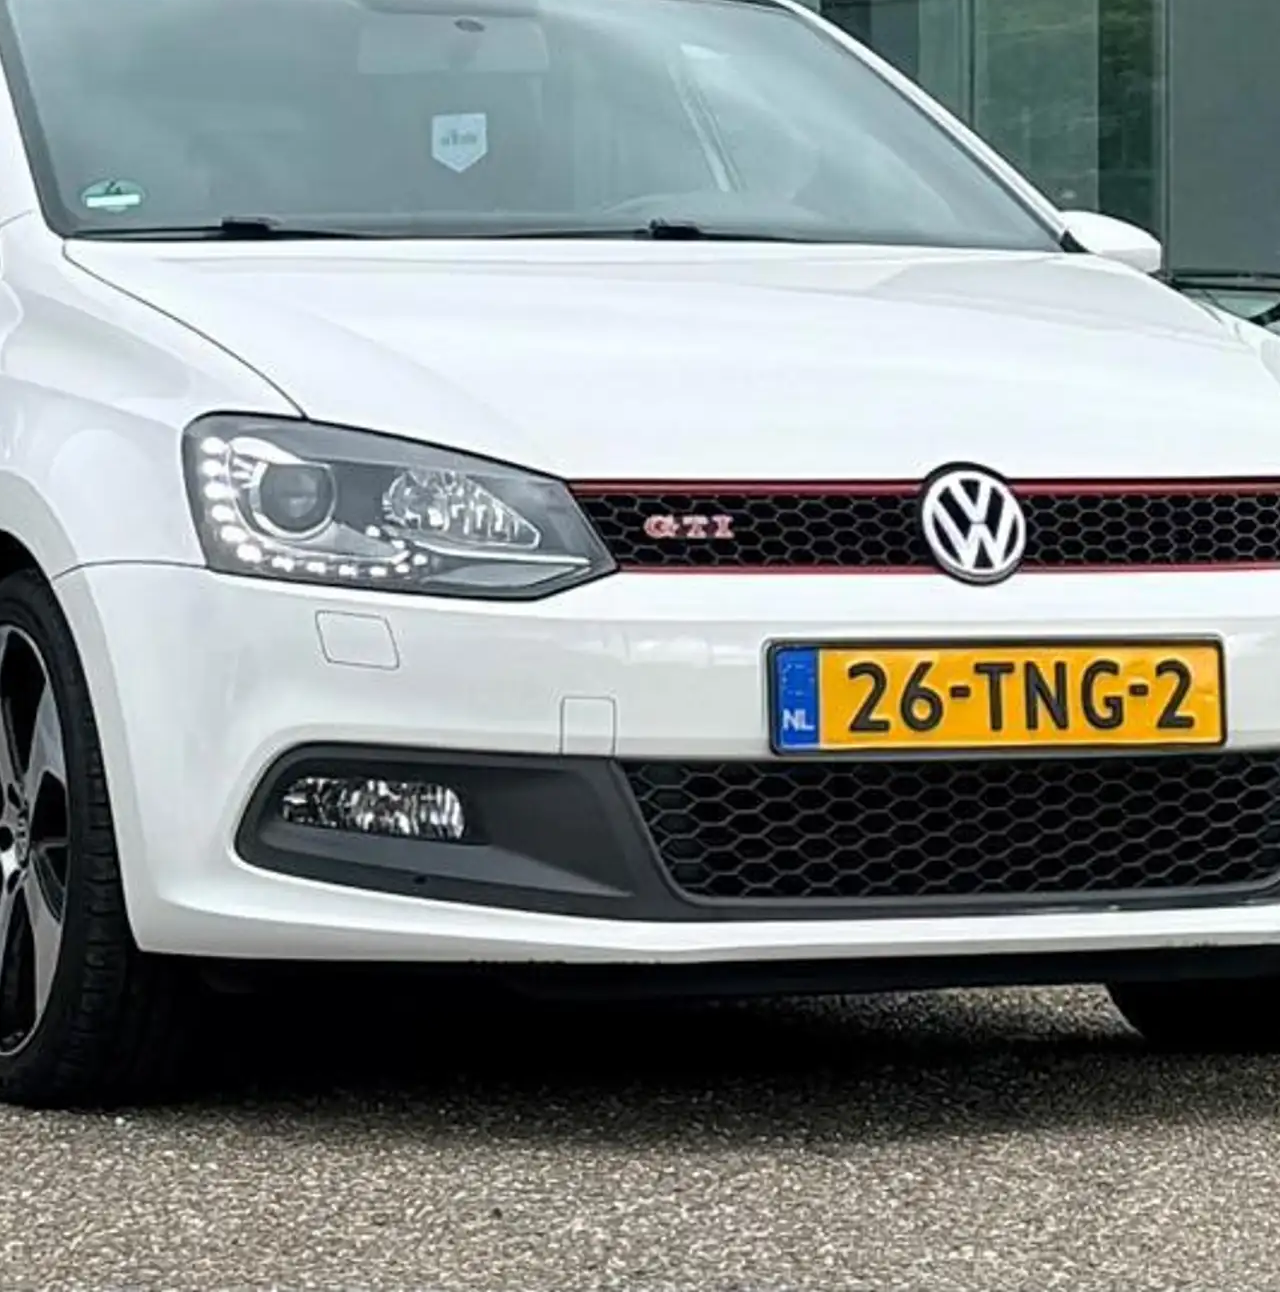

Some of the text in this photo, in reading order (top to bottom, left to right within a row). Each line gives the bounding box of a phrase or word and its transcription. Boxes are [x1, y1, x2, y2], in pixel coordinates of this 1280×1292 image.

[643, 514, 735, 539] GTI
[847, 658, 1196, 734] 26-TNG-2
[782, 711, 814, 731] NL
